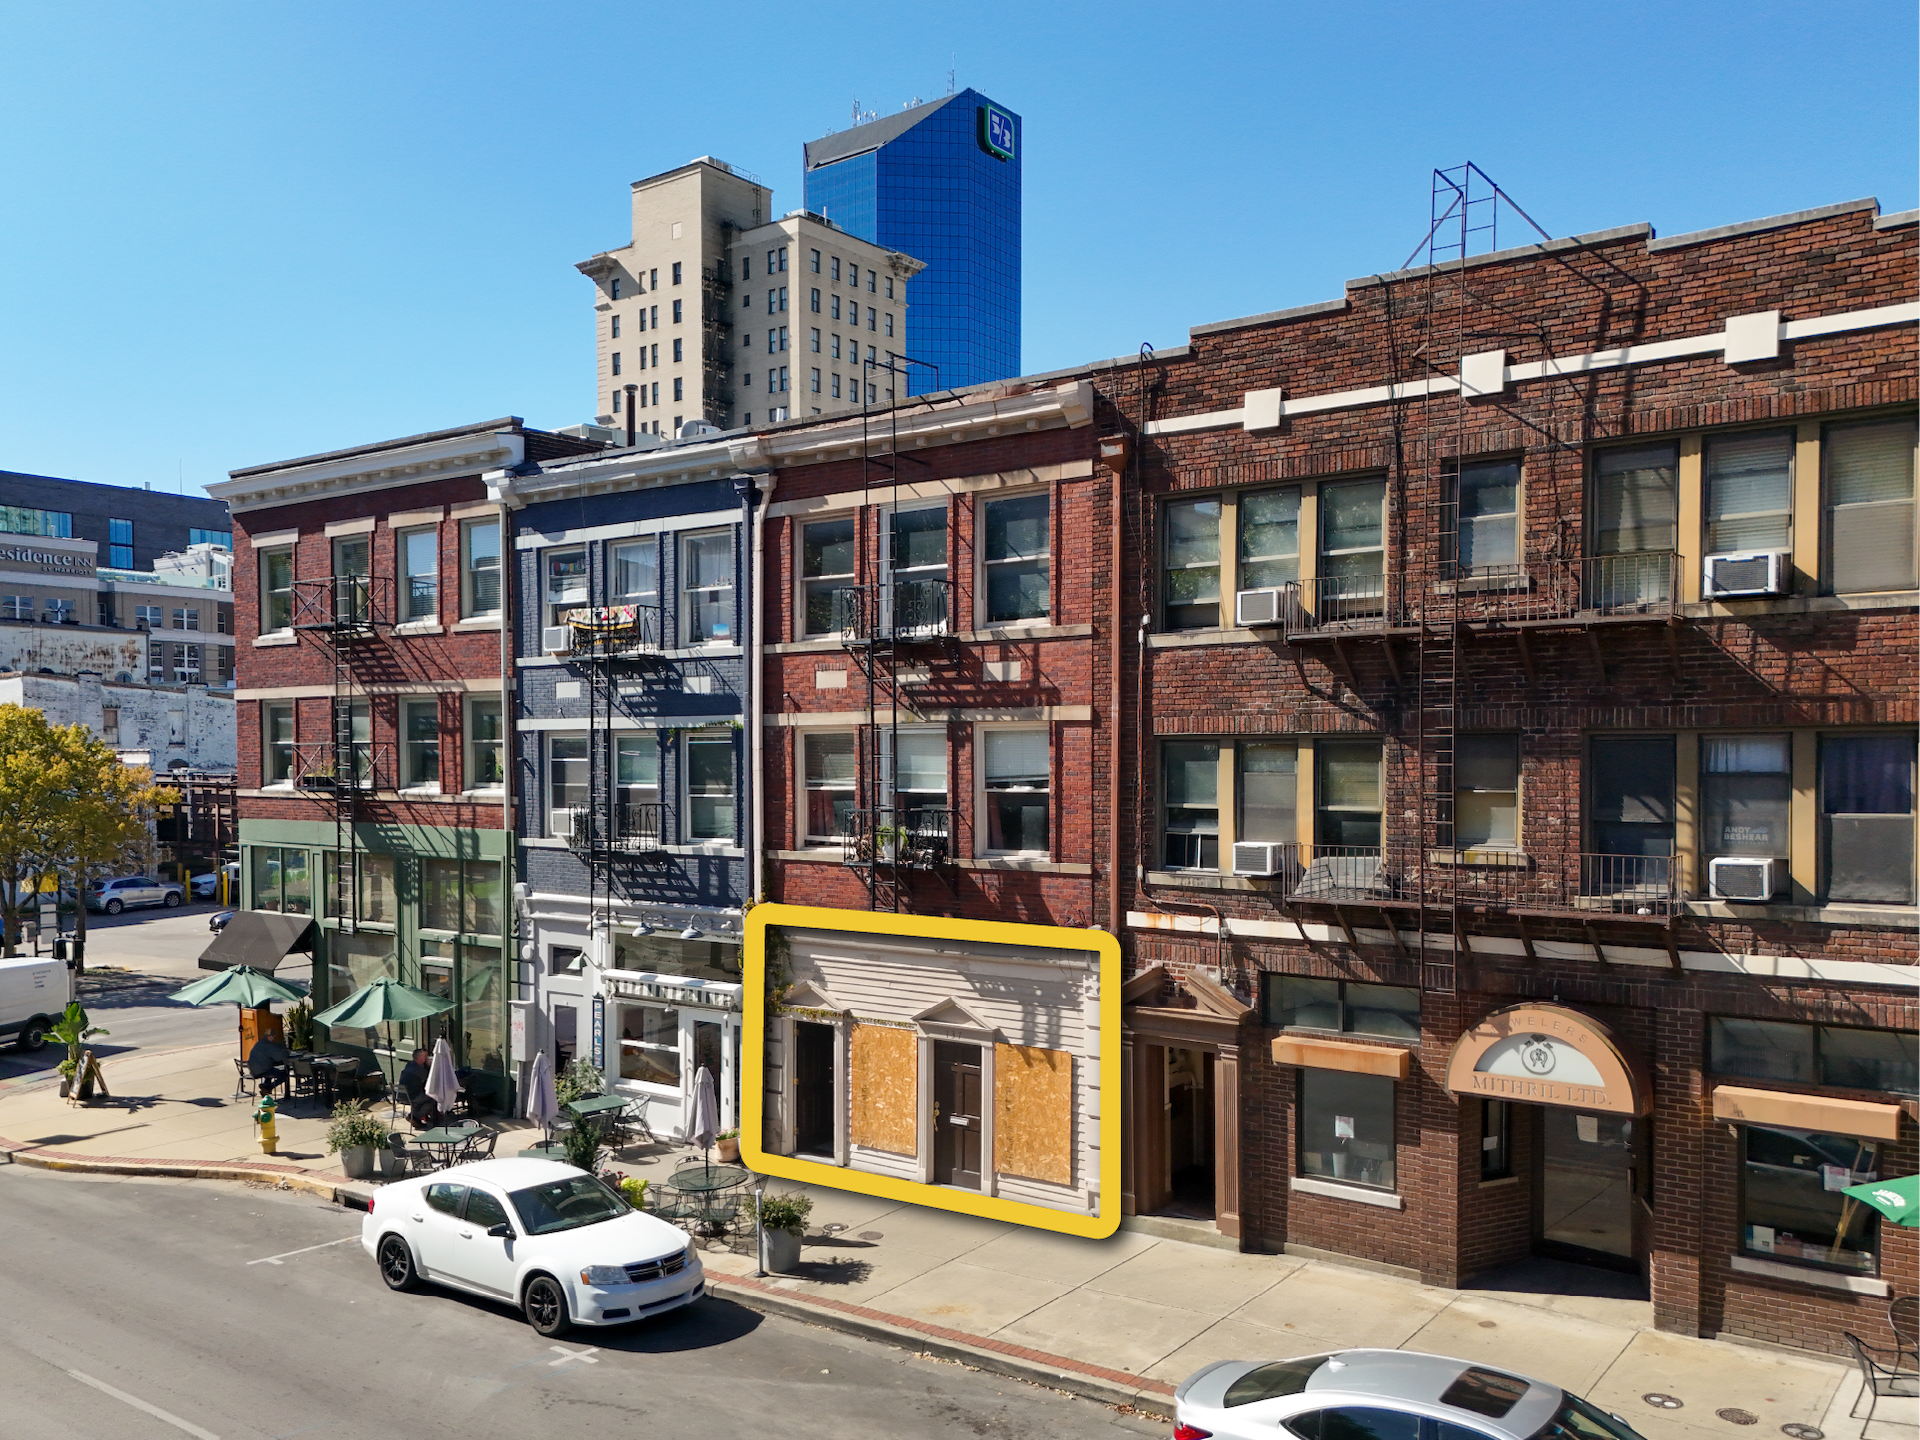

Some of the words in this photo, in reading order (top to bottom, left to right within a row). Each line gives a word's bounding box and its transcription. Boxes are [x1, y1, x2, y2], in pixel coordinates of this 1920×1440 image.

[74, 556, 93, 568] INN
[54, 567, 92, 576] MARRIOTT
[1724, 826, 1751, 834] ANDY
[1723, 833, 1769, 842] BESHEAR
[593, 1002, 602, 1055] PEARLS
[946, 1030, 962, 1040] 137
[1472, 1074, 1561, 1100] MITHRIL
[1566, 1086, 1613, 1106] LTD.
